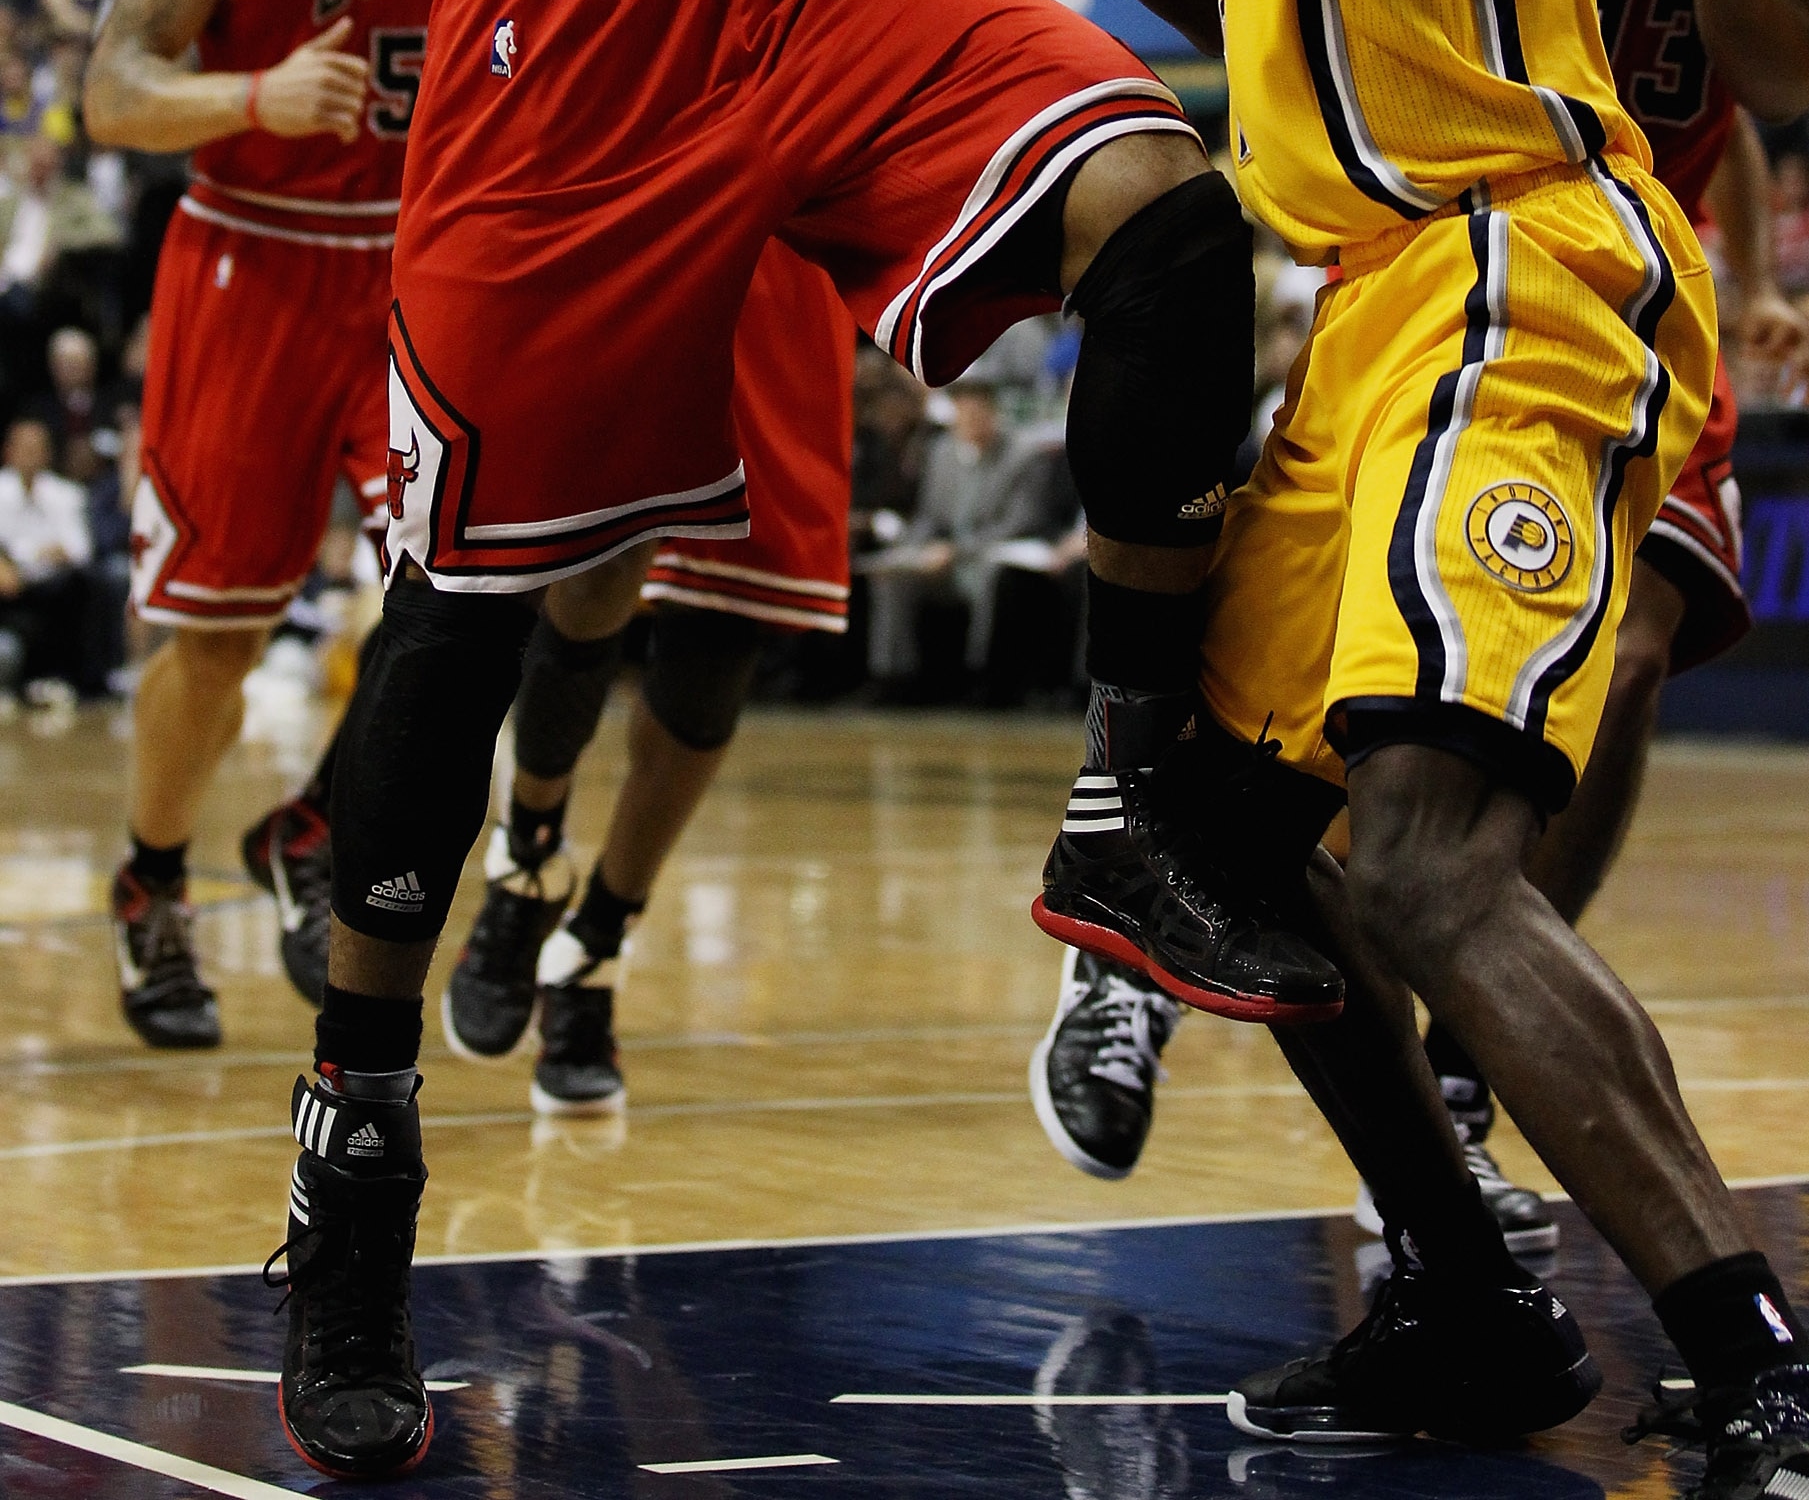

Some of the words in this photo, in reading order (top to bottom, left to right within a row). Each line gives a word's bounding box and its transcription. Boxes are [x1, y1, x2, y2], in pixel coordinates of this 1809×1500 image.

[491, 64, 508, 76] NBA
[367, 25, 428, 143] 5
[371, 884, 426, 902] adidas
[347, 1136, 385, 1148] adidas
